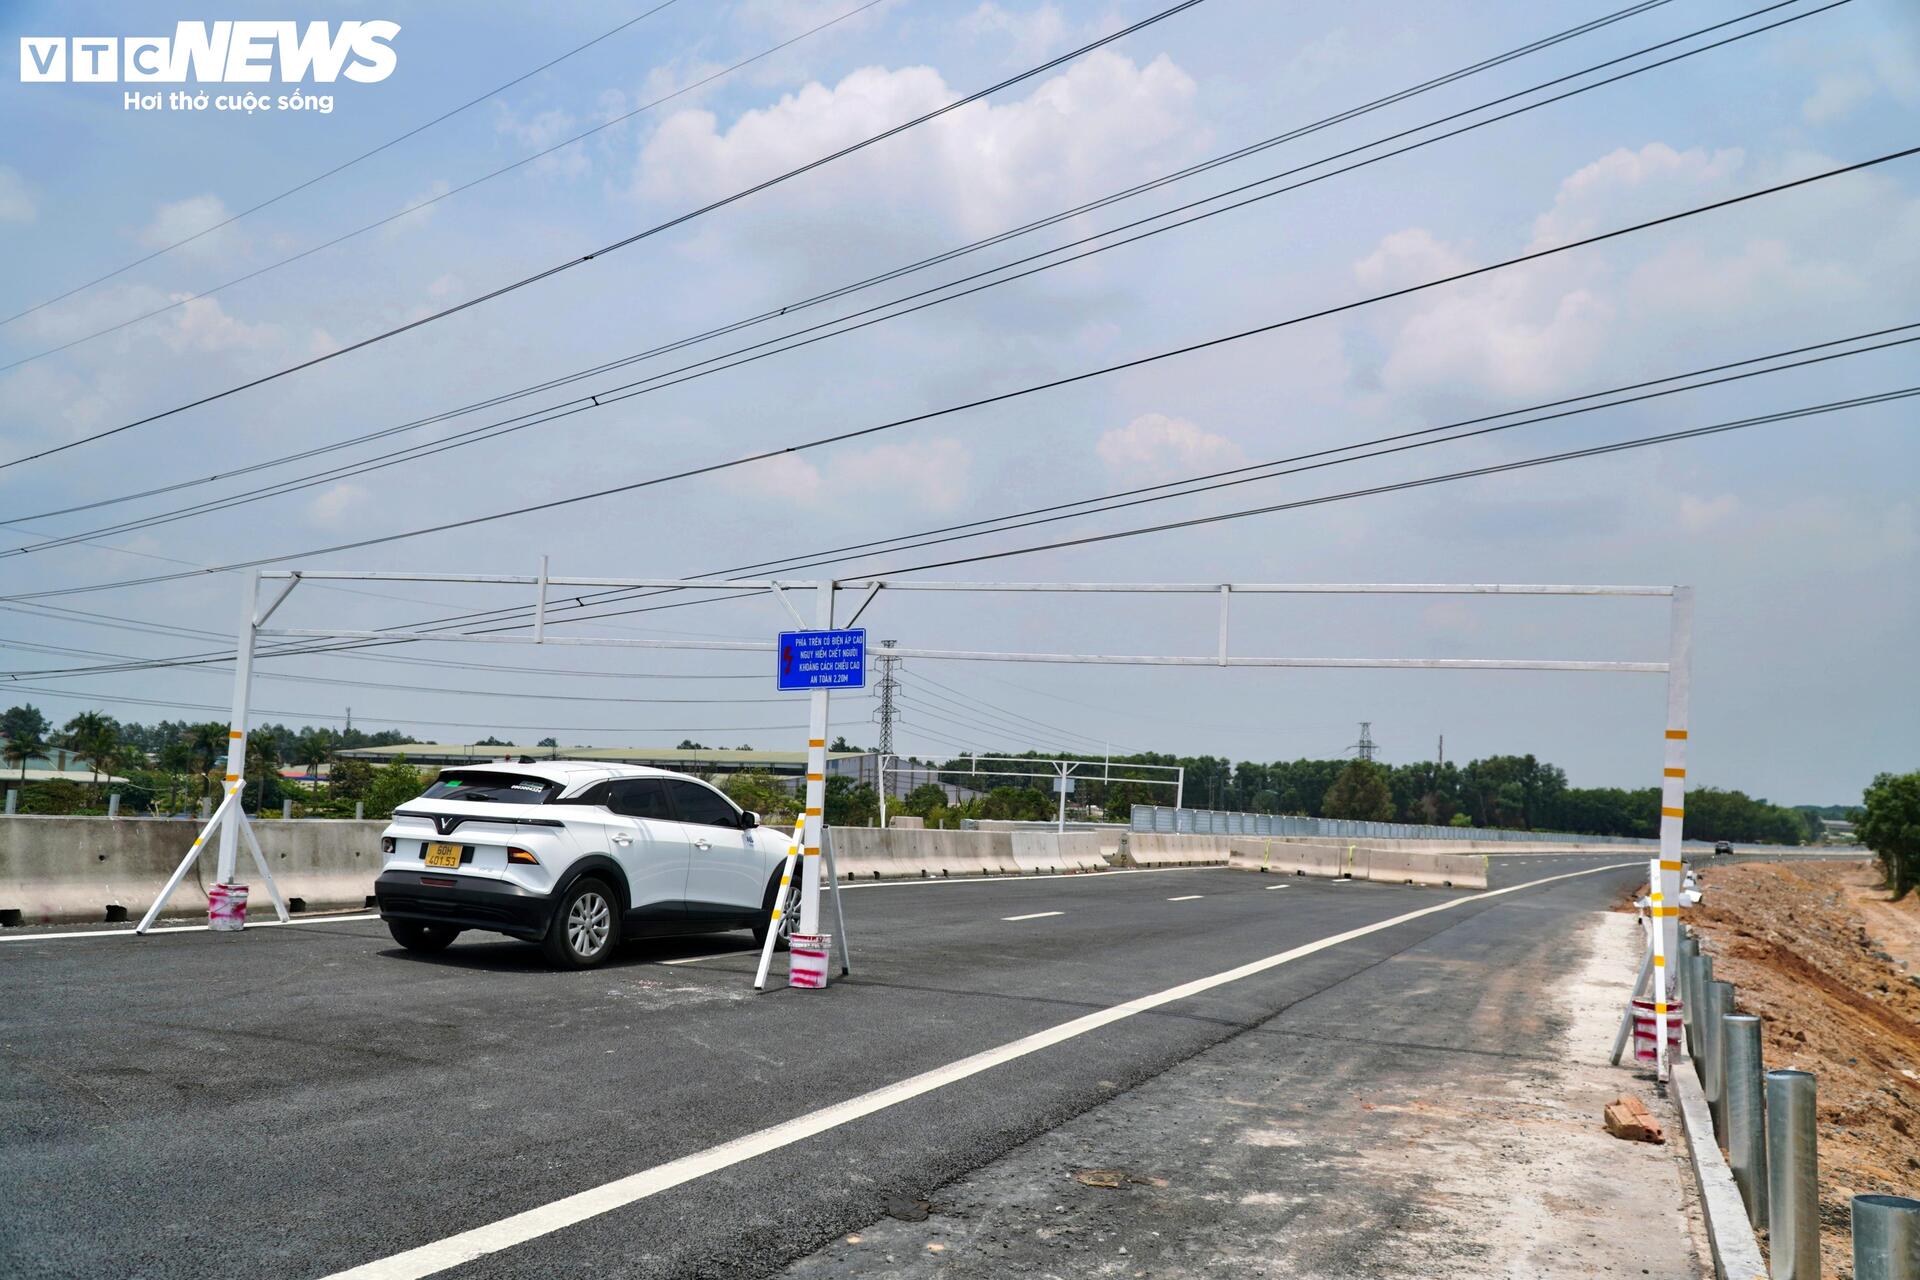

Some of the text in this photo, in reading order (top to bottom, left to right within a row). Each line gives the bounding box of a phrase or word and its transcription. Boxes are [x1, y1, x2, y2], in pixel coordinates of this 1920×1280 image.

[852, 635, 863, 644] CAO
[800, 650, 813, 659] NGUY
[849, 661, 860, 670] CAO
[810, 674, 818, 684] AN
